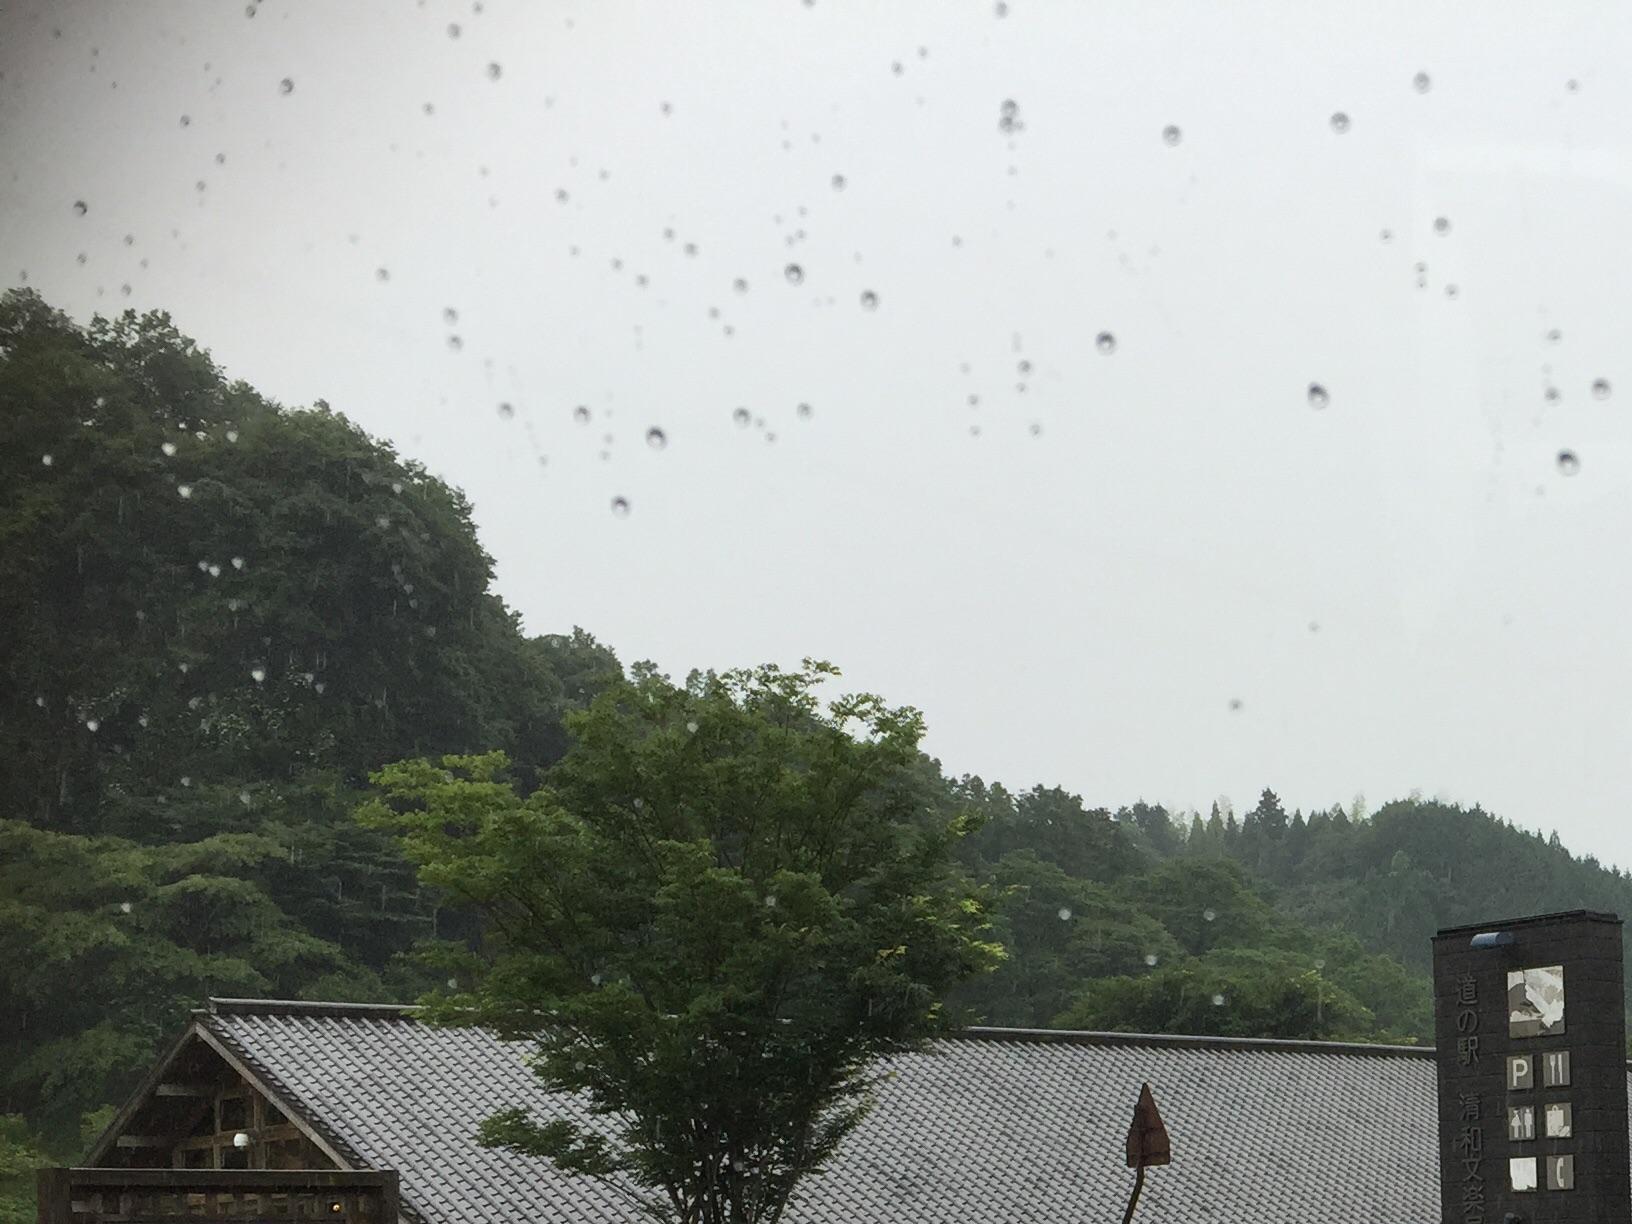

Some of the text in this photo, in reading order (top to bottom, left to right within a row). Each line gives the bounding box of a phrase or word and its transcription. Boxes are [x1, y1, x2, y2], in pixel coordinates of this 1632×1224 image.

[1455, 976, 1481, 1065] 道の駅
[1512, 1058, 1529, 1087] P
